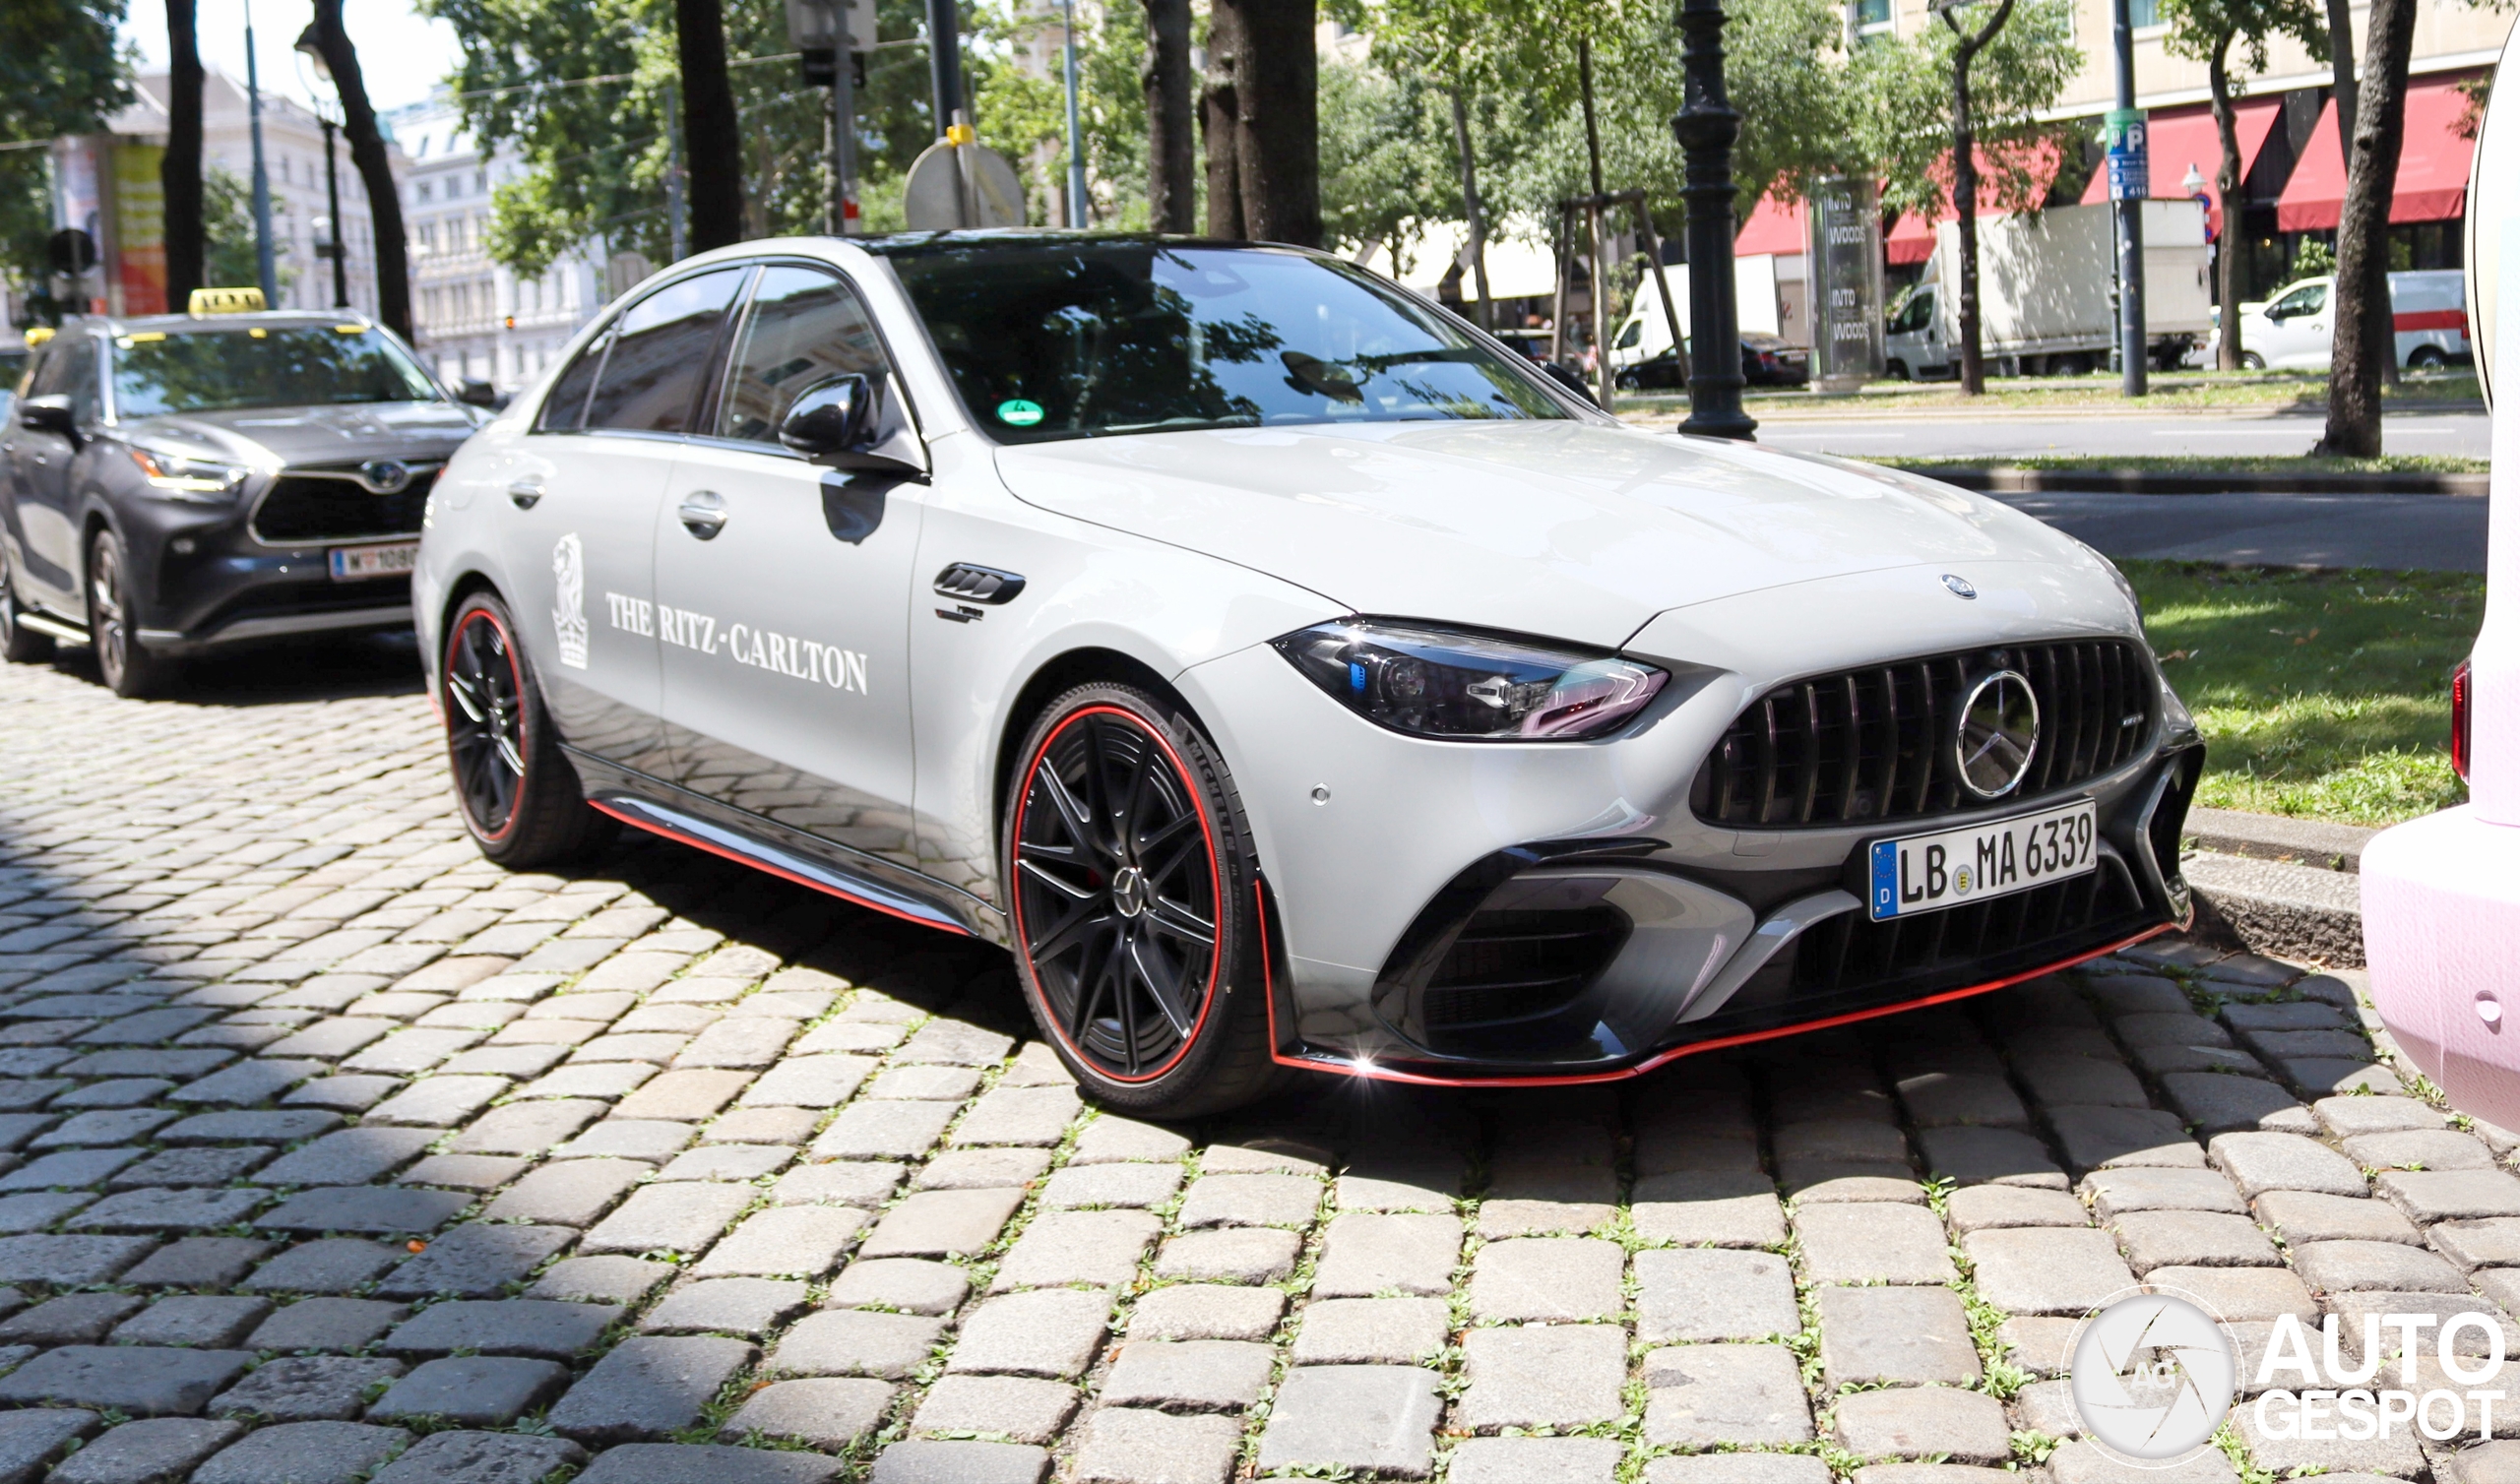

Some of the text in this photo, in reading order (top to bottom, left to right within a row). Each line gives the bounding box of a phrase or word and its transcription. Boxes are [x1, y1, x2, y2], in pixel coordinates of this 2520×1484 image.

[2127, 128, 2144, 153] P
[1830, 225, 1866, 245] WOODS
[1832, 288, 1856, 307] INTO
[1833, 322, 1869, 340] WOODS
[605, 591, 655, 638] THE
[1188, 741, 1236, 851] MICHELIN
[1901, 812, 2093, 904] LB MA 6339
[1880, 888, 1890, 904] D
